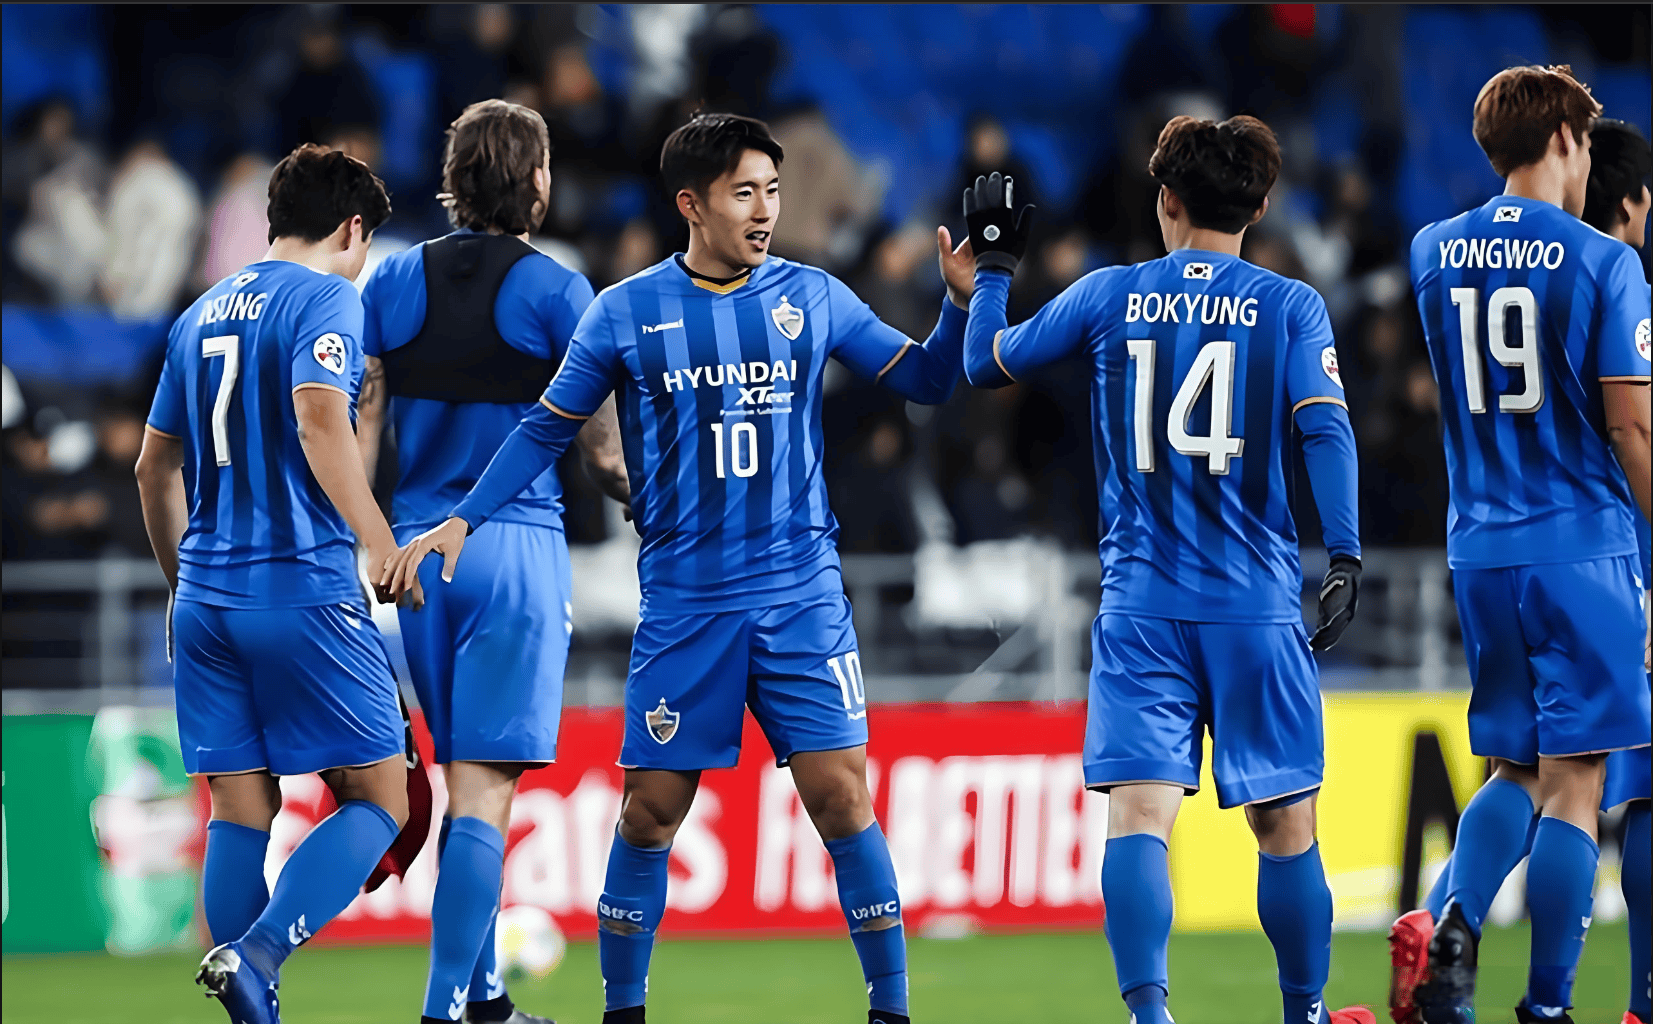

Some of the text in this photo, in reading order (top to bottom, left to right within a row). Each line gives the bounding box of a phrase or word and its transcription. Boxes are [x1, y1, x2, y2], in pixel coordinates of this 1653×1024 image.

[1439, 238, 1565, 270] YONGWOO
[1125, 292, 1258, 327] BOKYUNG
[662, 360, 798, 393] HYUNDAI
[1450, 287, 1545, 414] 19
[202, 335, 240, 467] 7
[1126, 340, 1245, 475] 14
[711, 422, 759, 479] 10
[827, 651, 866, 710] 10
